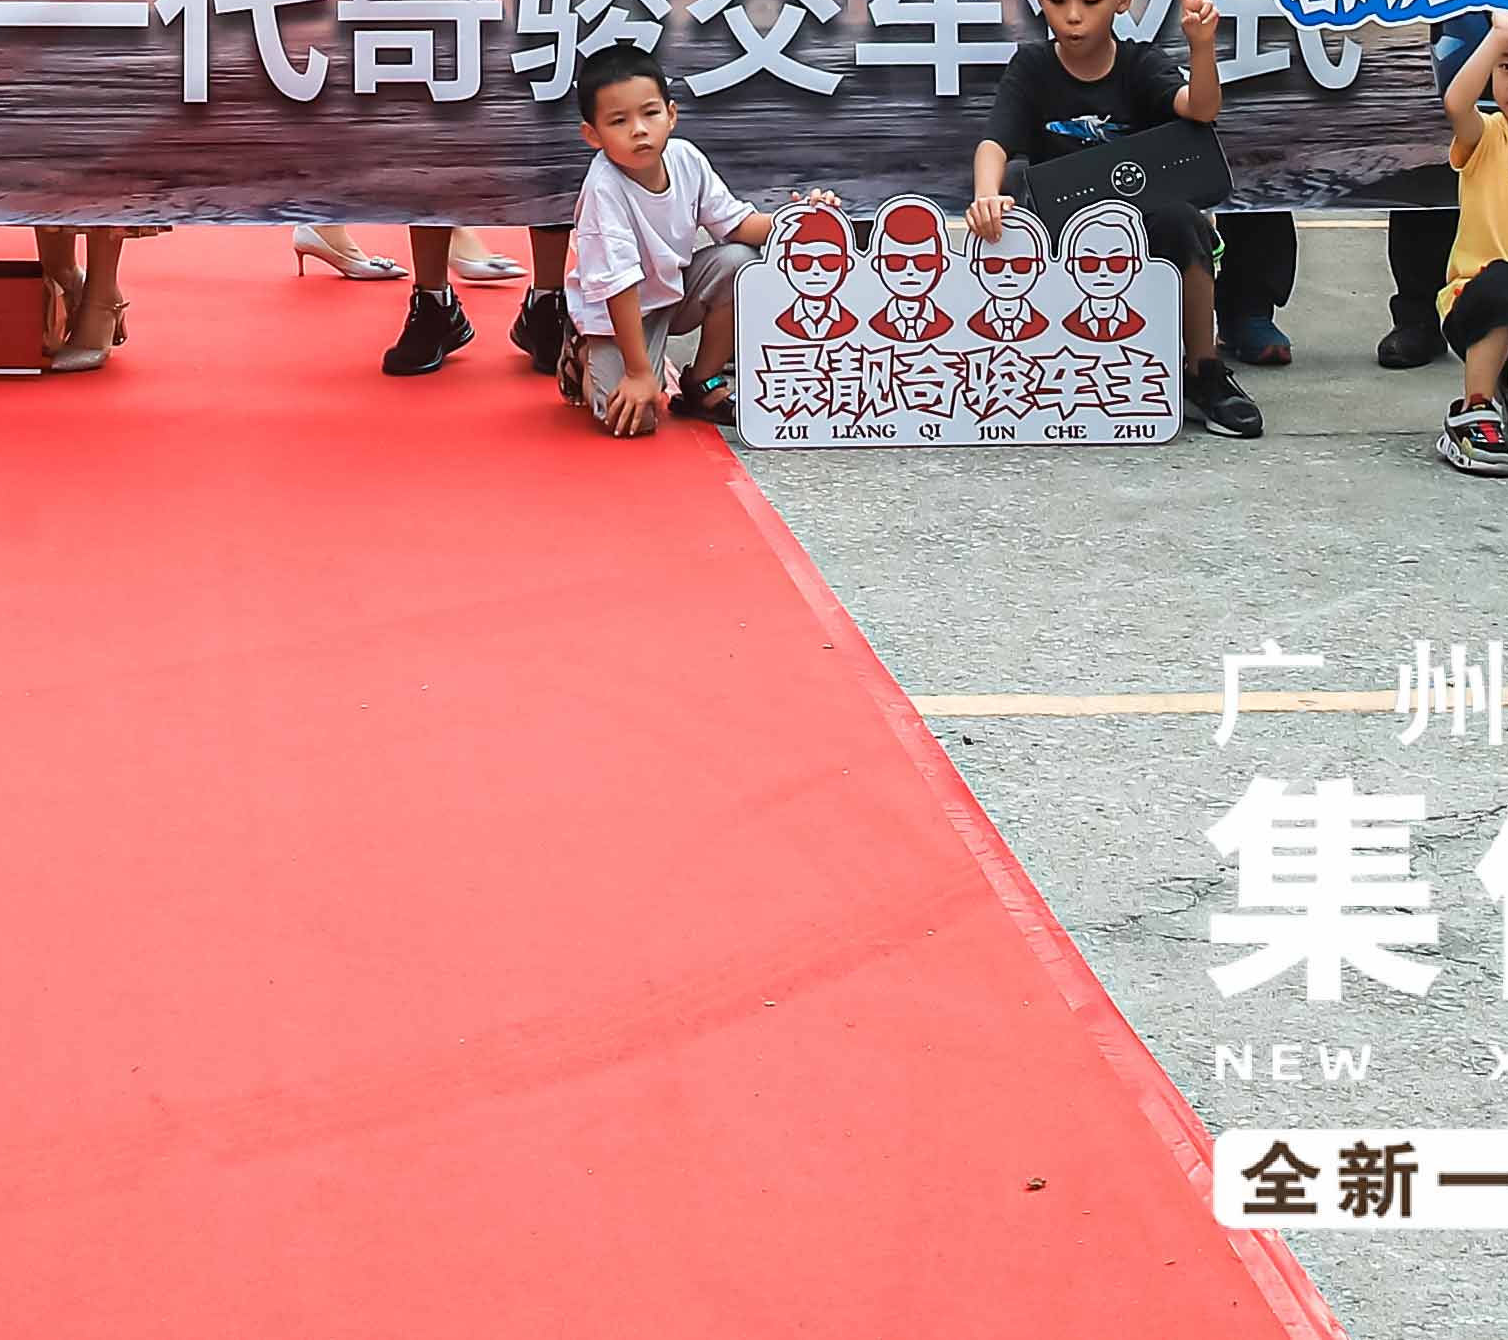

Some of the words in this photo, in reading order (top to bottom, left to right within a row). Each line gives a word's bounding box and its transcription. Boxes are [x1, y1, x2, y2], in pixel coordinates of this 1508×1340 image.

[756, 342, 1173, 421] 最靓奇骏车主
[774, 424, 810, 440] ZUI
[831, 424, 898, 439] LIANG
[918, 423, 942, 440] QI
[978, 425, 1016, 440] JUN
[1044, 425, 1087, 439] CHE
[1113, 424, 1158, 439] ZHU
